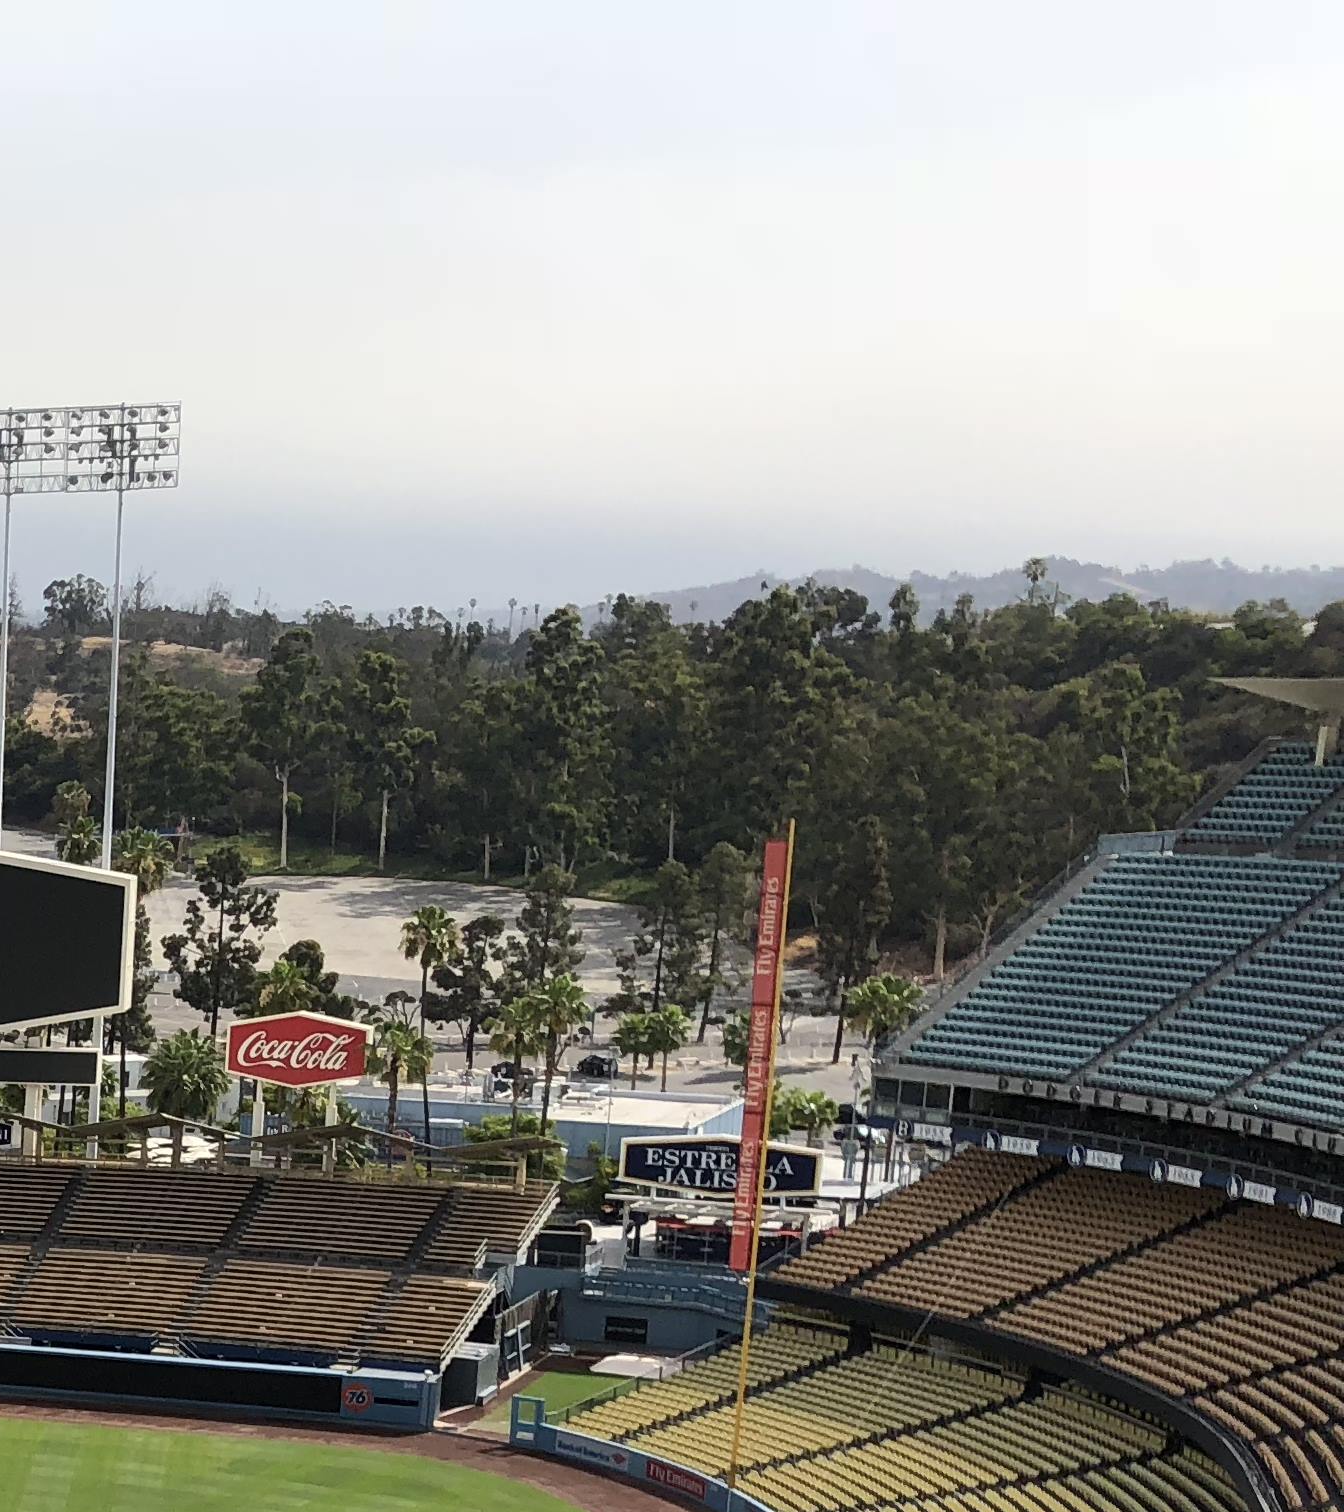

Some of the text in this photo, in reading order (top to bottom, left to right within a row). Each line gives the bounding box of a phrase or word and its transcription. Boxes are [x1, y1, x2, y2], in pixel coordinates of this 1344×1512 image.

[759, 876, 780, 948] Emirates
[236, 1030, 356, 1071] Coca-Cola
[644, 1147, 794, 1176] ESTREA
[657, 1167, 778, 1191] JALISO
[347, 1390, 369, 1405] 76
[648, 1460, 704, 1496] Fly Emirates
